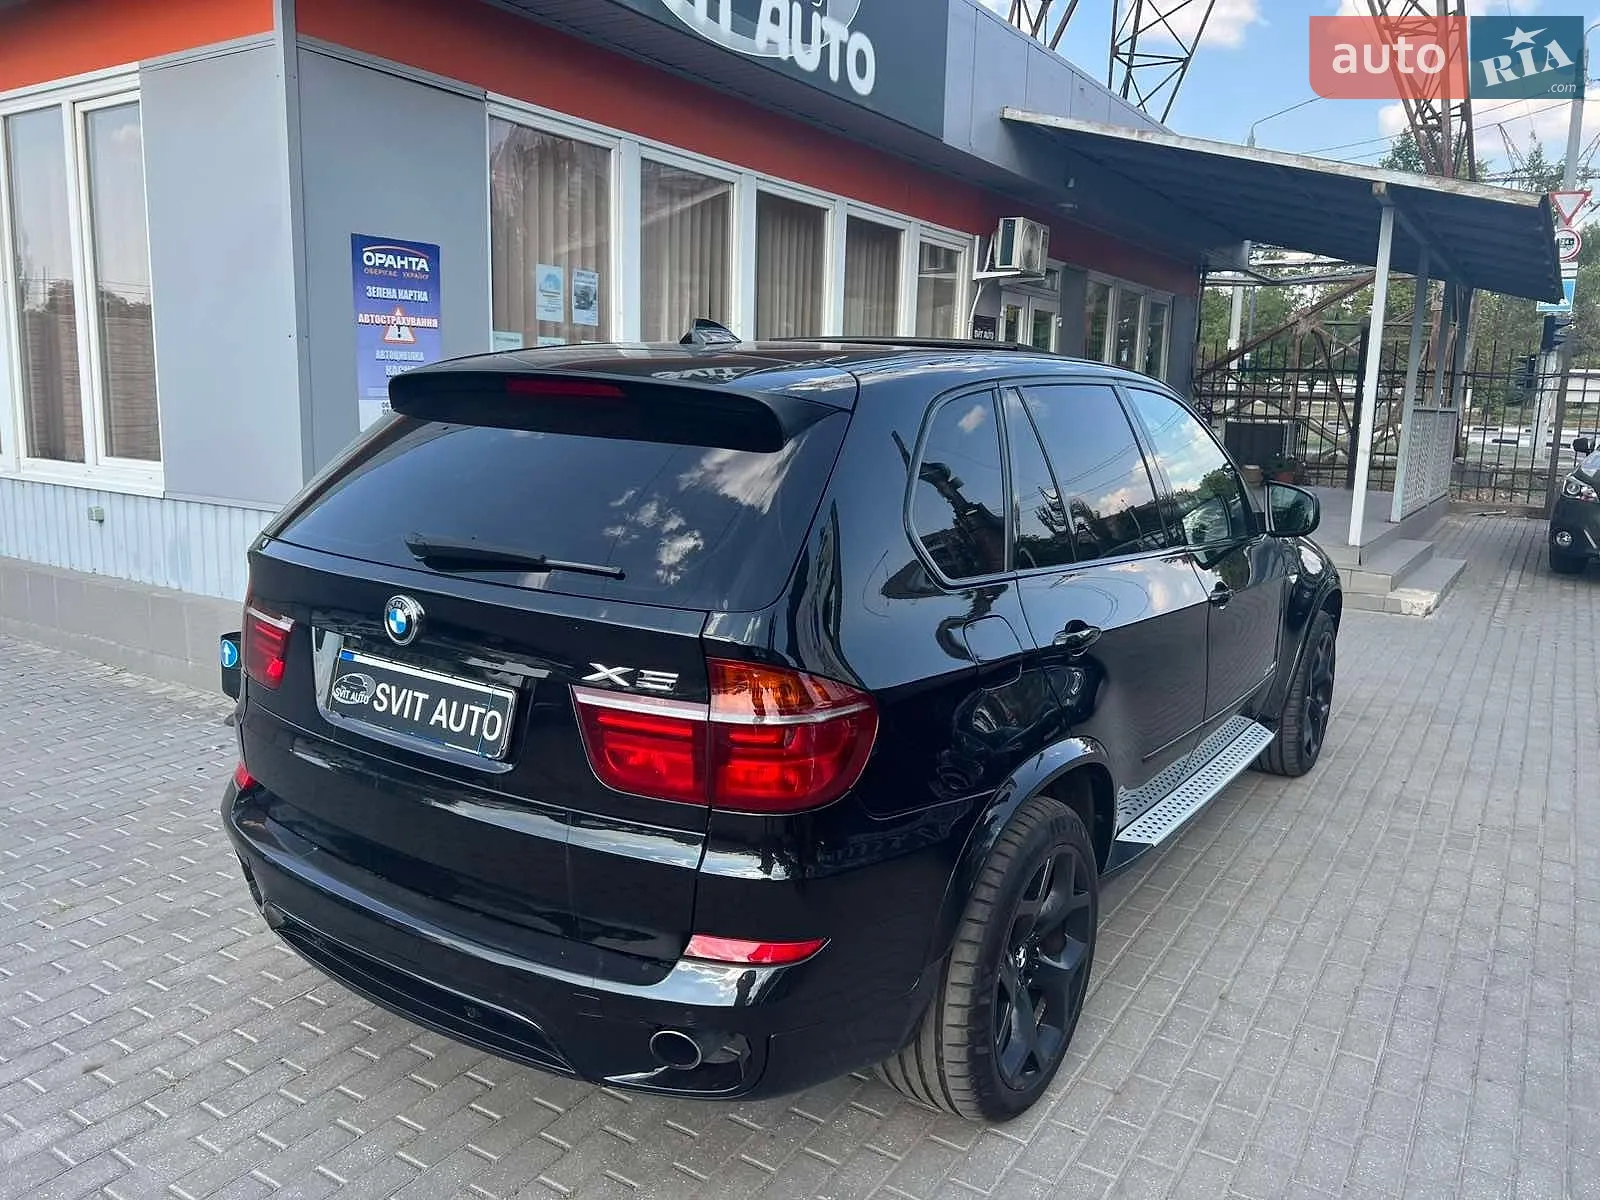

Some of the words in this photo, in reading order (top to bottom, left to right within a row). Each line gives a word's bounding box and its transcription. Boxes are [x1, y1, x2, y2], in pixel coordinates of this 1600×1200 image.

[755, 0, 875, 95] AUTO
[362, 251, 430, 271] ОРАНТА
[366, 285, 397, 300] ЗЕЛЕНА
[358, 313, 438, 328] АВТОСТРАХУВАННЯ
[373, 682, 429, 722] SVIT
[430, 699, 503, 742] AUTO
